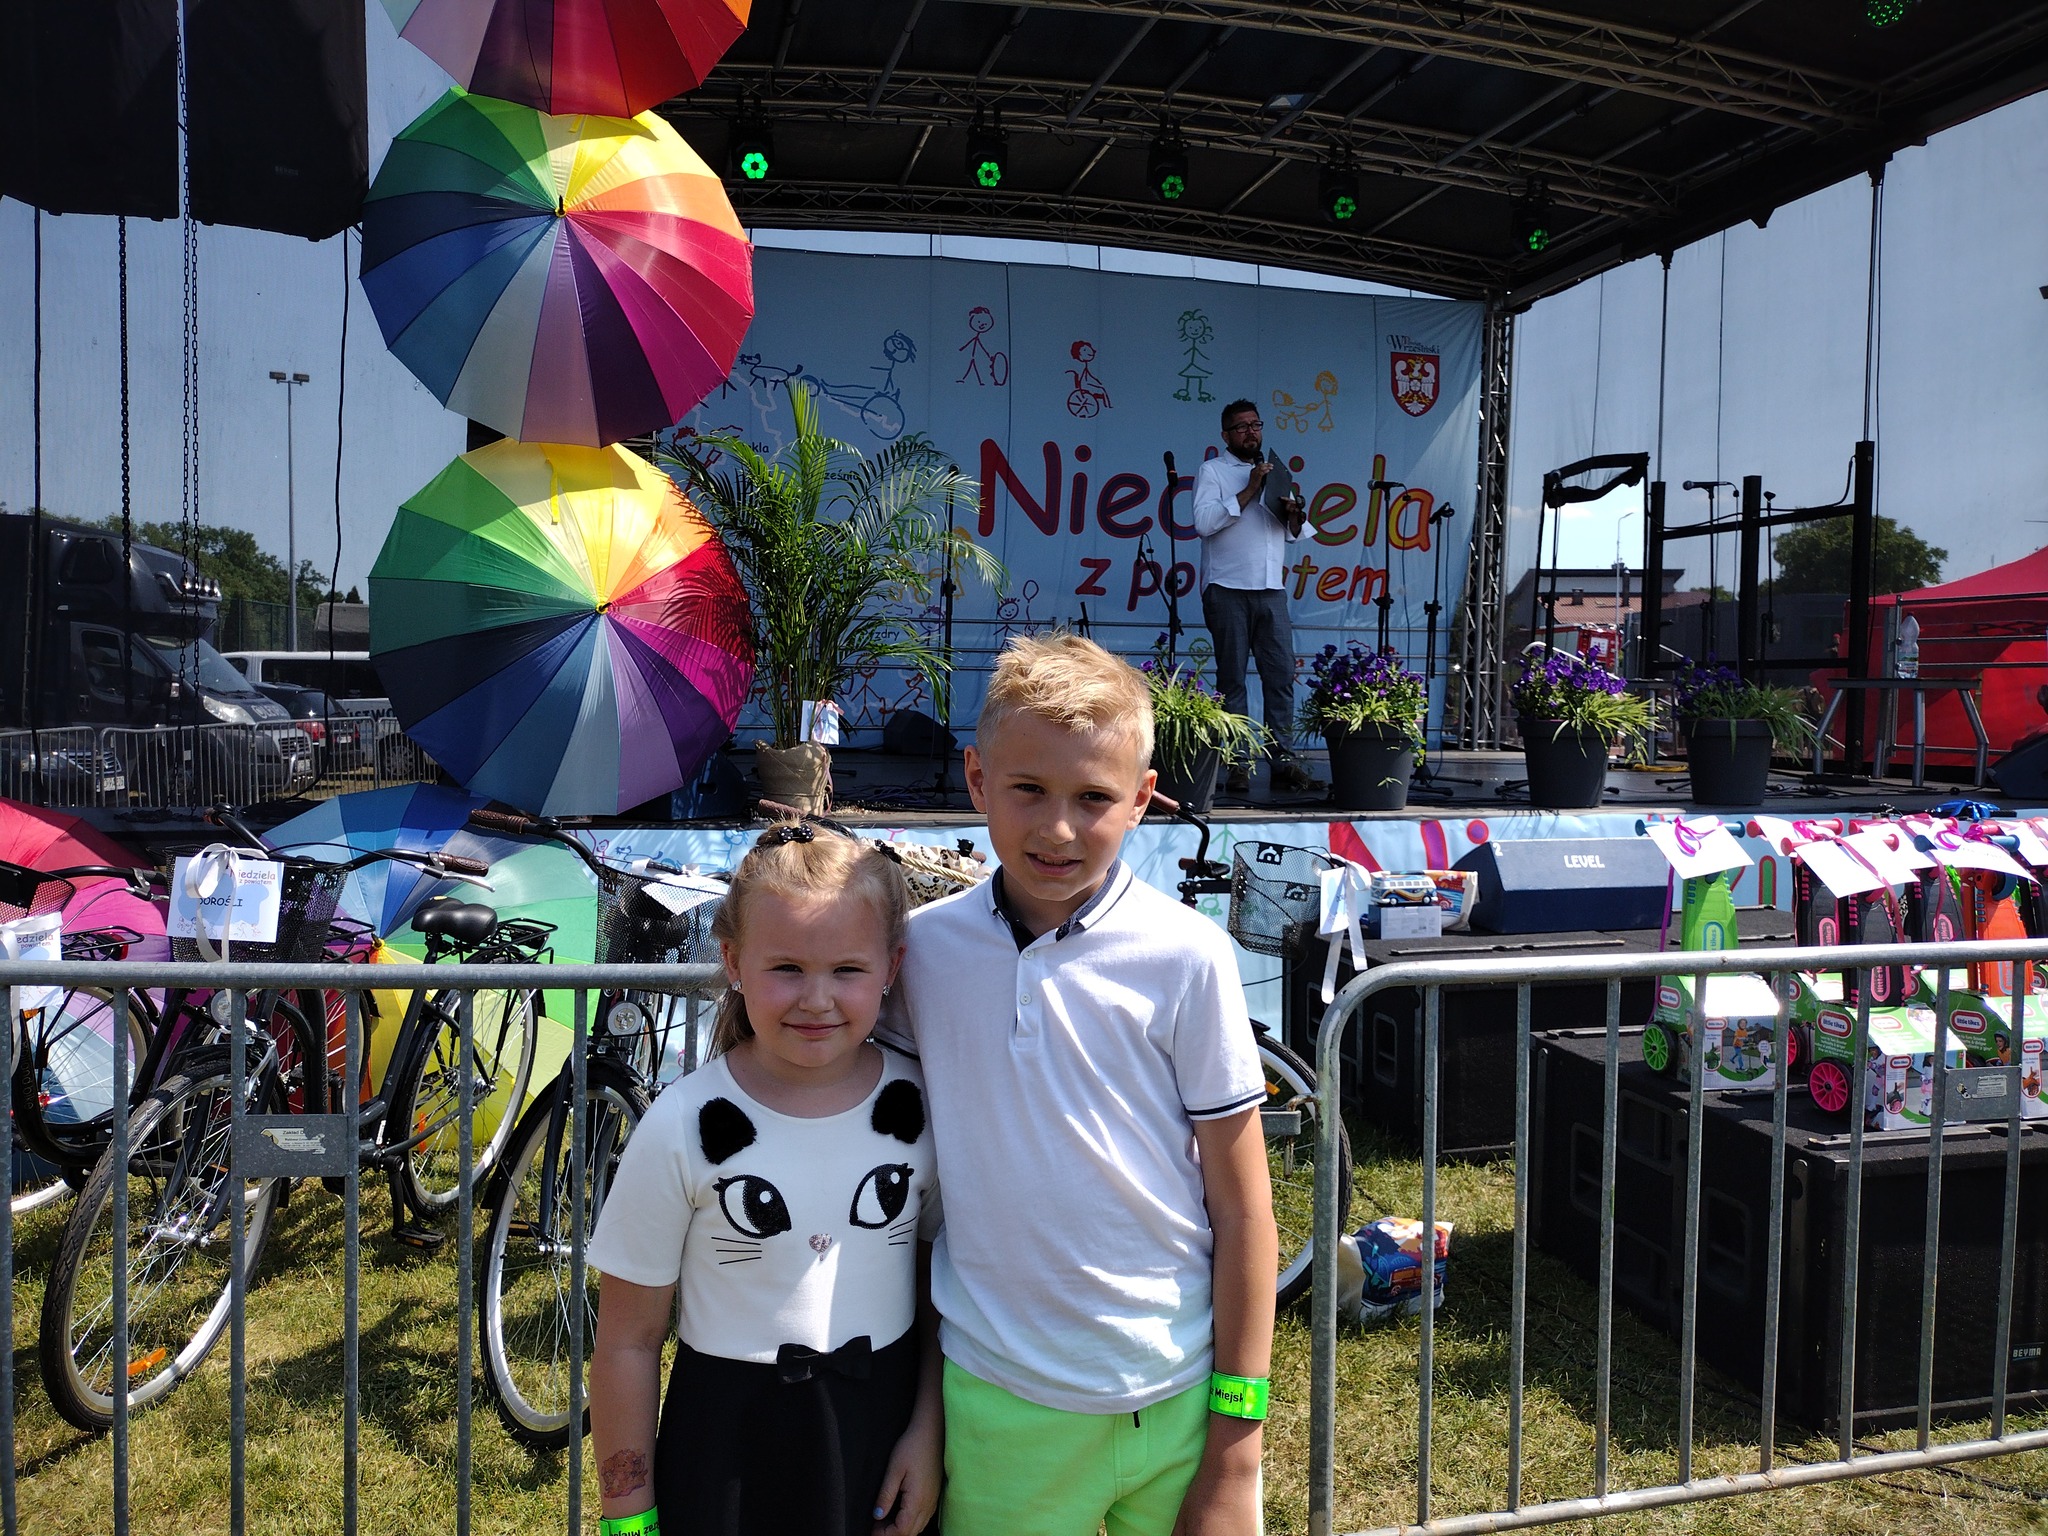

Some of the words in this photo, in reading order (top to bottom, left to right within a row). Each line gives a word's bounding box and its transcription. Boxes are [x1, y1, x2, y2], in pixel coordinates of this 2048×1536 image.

[1075, 557, 1111, 596] z
[1493, 843, 1503, 856] 2
[1564, 855, 1605, 868] LEVEL
[2013, 1347, 2042, 1357] BEYMA
